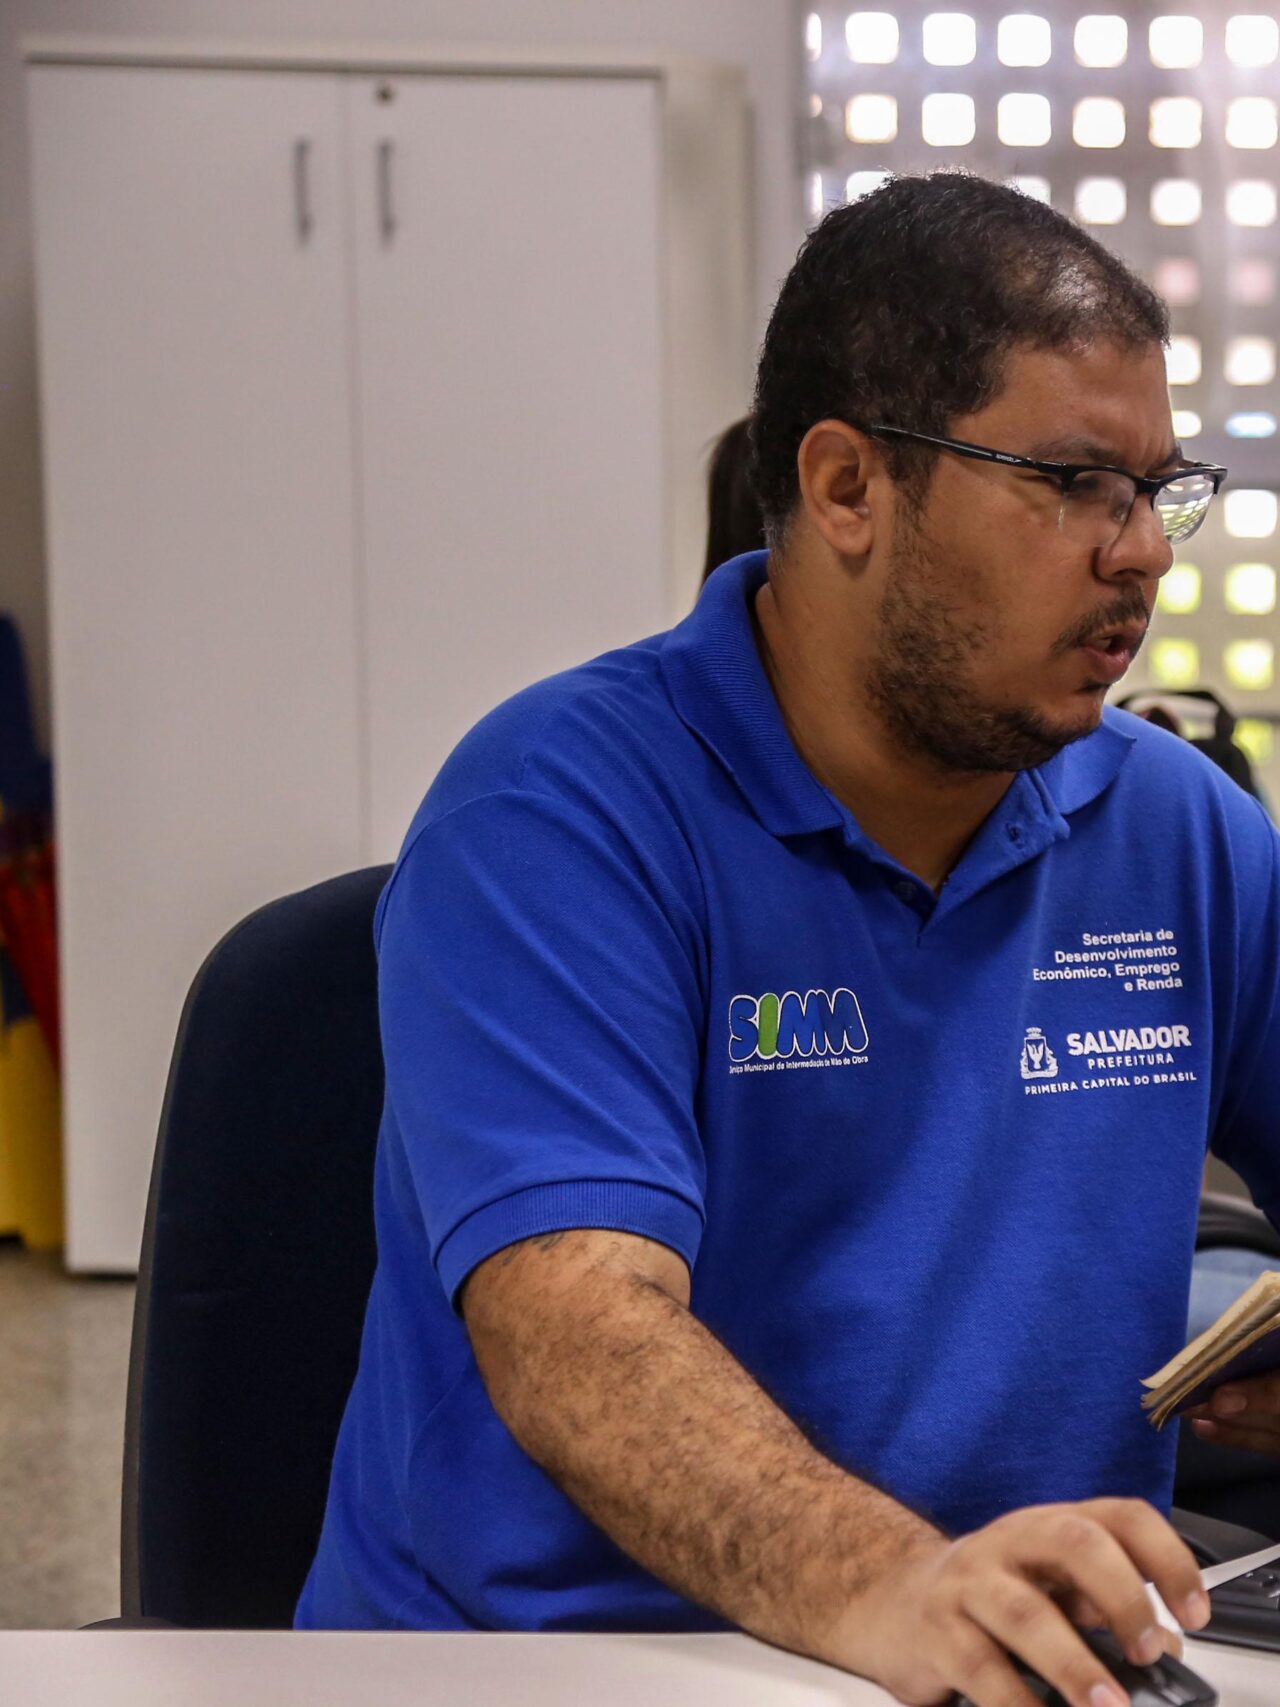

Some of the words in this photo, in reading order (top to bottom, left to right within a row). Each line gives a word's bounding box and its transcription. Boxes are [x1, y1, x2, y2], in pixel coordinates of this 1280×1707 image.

[1083, 931, 1153, 946] Secretaria
[1156, 929, 1174, 940] de
[1054, 947, 1177, 963] Desenvolvimento
[1033, 967, 1112, 981] Econômico,
[1114, 962, 1180, 978] Emprego
[1124, 983, 1133, 991] e
[1138, 977, 1183, 991] Renda
[728, 987, 869, 1062] SIMM
[1066, 1024, 1192, 1057] SALVADOR
[744, 1062, 775, 1073] Municipal
[852, 1055, 868, 1064] Obra
[1087, 1053, 1175, 1069] PREFEITURA
[1025, 1082, 1078, 1095] PRIMEIRA
[1082, 1077, 1130, 1089] CAPITAL
[1134, 1076, 1150, 1085] DO
[1154, 1073, 1197, 1083] BRASIL
